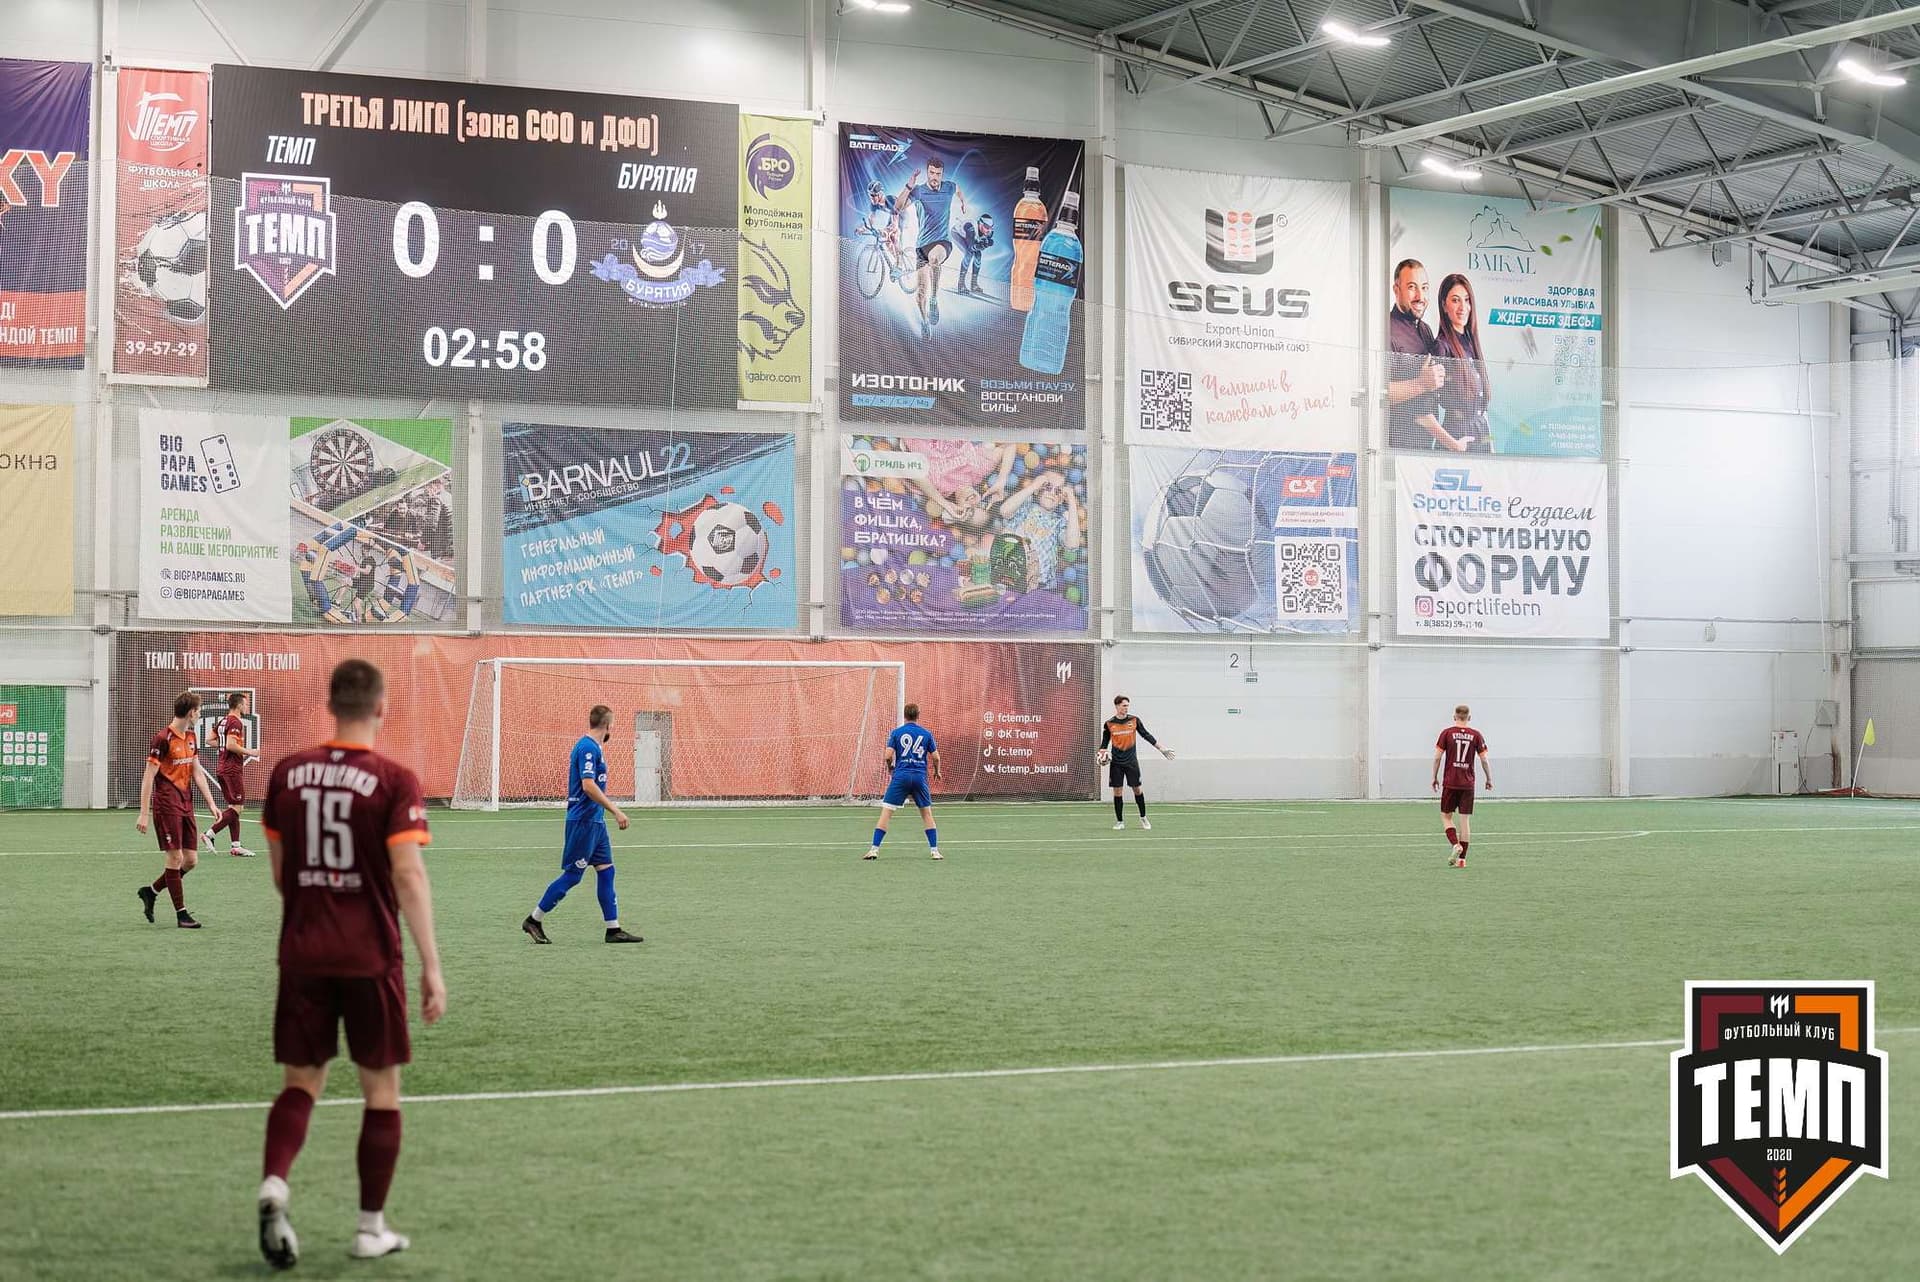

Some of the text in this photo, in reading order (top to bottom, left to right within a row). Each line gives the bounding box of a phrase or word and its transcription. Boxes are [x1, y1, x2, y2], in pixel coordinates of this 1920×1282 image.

[301, 92, 659, 156] ТРЕТЬЯ ЛИГА (зона СФО и ДФО)
[266, 135, 316, 165] ТЕМП
[128, 164, 199, 178] ФУТБОЛЬНАЯ
[617, 162, 697, 194] БУРЯТИЯ
[143, 179, 179, 188] ШКОЛА
[743, 205, 803, 219] Молодёжная
[745, 216, 803, 230] футбольная
[246, 212, 326, 260] ТЕМП
[393, 201, 440, 278] 0
[532, 210, 577, 285] 0
[781, 232, 803, 242] лига
[1468, 252, 1536, 275] BAIKAL
[626, 280, 691, 299] БУРЯТИЯ
[1547, 286, 1595, 297] ЗДОРОВАЯ
[1168, 280, 1310, 319] SEUS
[1503, 295, 1595, 309] И КРАСИВАЯ УЛЫБКА
[1496, 311, 1595, 328] ЖДЕТ ТЕБЯ ЗДЕСЬ!
[39, 326, 78, 345] ТЕМП!
[1168, 335, 1222, 348] СИБИРСКИЙ
[1223, 339, 1285, 352] ЭКСПОРТНЫЙ
[125, 340, 198, 356] 39-57-29
[423, 326, 547, 371] 02:58
[851, 373, 966, 393] ИЗОТОНИК
[980, 379, 1034, 391] ВОЗЬМИ
[1201, 374, 1278, 400] Чемпион
[980, 391, 1063, 403] ВОССТАНОВИ
[1279, 400, 1300, 420] из
[1303, 385, 1337, 412] нас!
[980, 402, 1020, 413] СИЛЫ.
[160, 434, 182, 452] BIG
[0, 454, 57, 470] окна
[160, 454, 196, 473] PAPA
[874, 460, 905, 469] ГРИЛЬ
[160, 473, 208, 493] GAMES
[1432, 468, 1482, 492] SL
[854, 493, 903, 510] В ЧЁМ
[1413, 493, 1502, 513] SportLife
[160, 507, 200, 523] АРЕНДА
[1507, 496, 1597, 527] Создаем
[854, 514, 922, 531] ФИШКА,
[160, 524, 232, 540] РАЗВЛЕЧЕНИЙ
[854, 532, 947, 547] БРАТИШКА?
[1414, 523, 1592, 551] СПОРТИВНУЮ
[160, 541, 279, 559] НА ВАШЕ МЕРОПРИЯТИЕ
[520, 526, 605, 559] ГЕНЕРАЛЬНЫЙ
[521, 545, 636, 585] ИНФОРМАЦИОННЫЙ
[1414, 551, 1590, 596] ФОРМУ
[173, 569, 246, 583] BIGPAPAGAMES.RU
[173, 587, 245, 601] @BIGPAPAGAMES
[520, 569, 644, 608] ПАРТНЕР ФК «ТЕМП»
[1436, 598, 1541, 618] sportlifebrn
[145, 652, 300, 671] ТЕМП, ТЕМП, ТОЛЬКО ТЕМП!
[1230, 653, 1240, 668] 2
[998, 713, 1041, 724] fctemp.ru
[998, 729, 1038, 739] ФК Темп
[900, 733, 924, 758] 94
[998, 746, 1033, 757] fc.temp
[1455, 739, 1471, 763] 17
[998, 763, 1068, 775] fctemp_barnaul
[300, 787, 355, 870] 15
